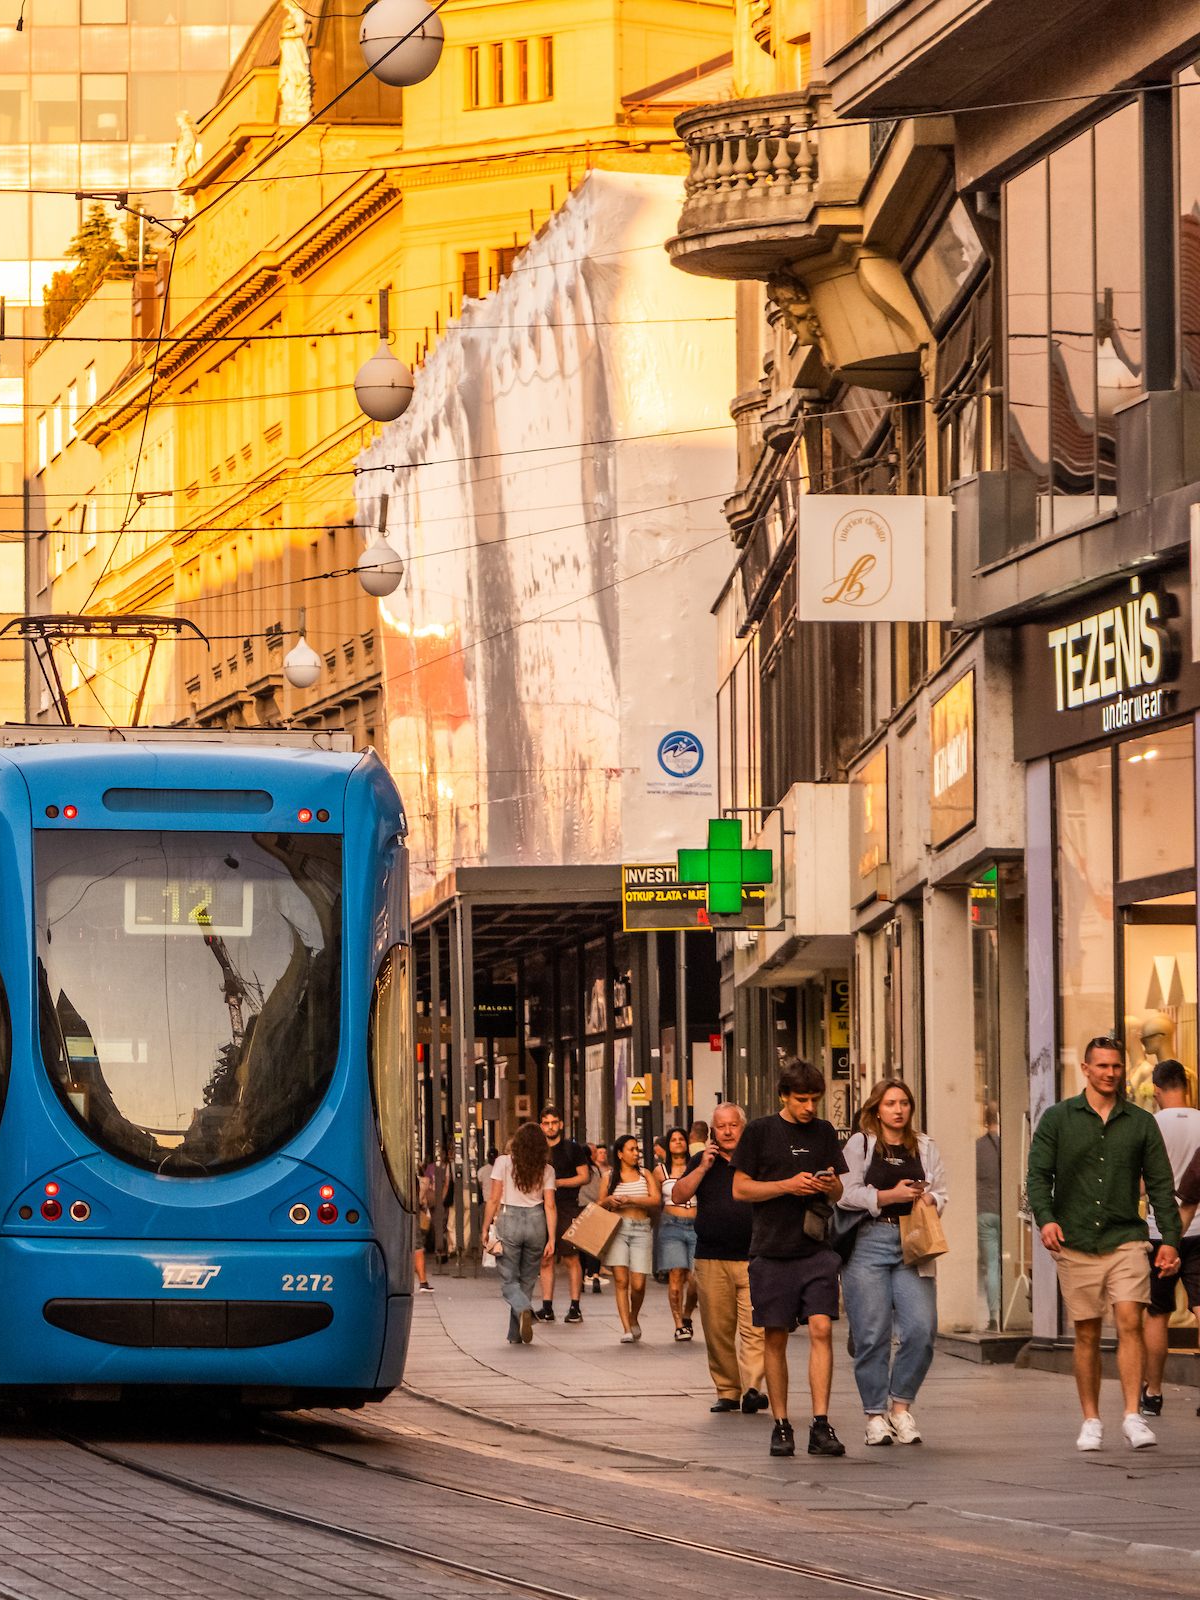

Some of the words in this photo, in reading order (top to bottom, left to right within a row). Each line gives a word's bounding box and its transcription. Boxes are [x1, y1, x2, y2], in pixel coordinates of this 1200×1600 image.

[838, 517, 864, 542] interior
[865, 516, 886, 542] design
[1102, 689, 1163, 732] underwear
[625, 868, 677, 883] INVESTI
[162, 881, 213, 924] 12
[626, 891, 654, 902] OTKUP
[656, 890, 682, 901] ZLATA
[282, 1275, 334, 1291] 2272
